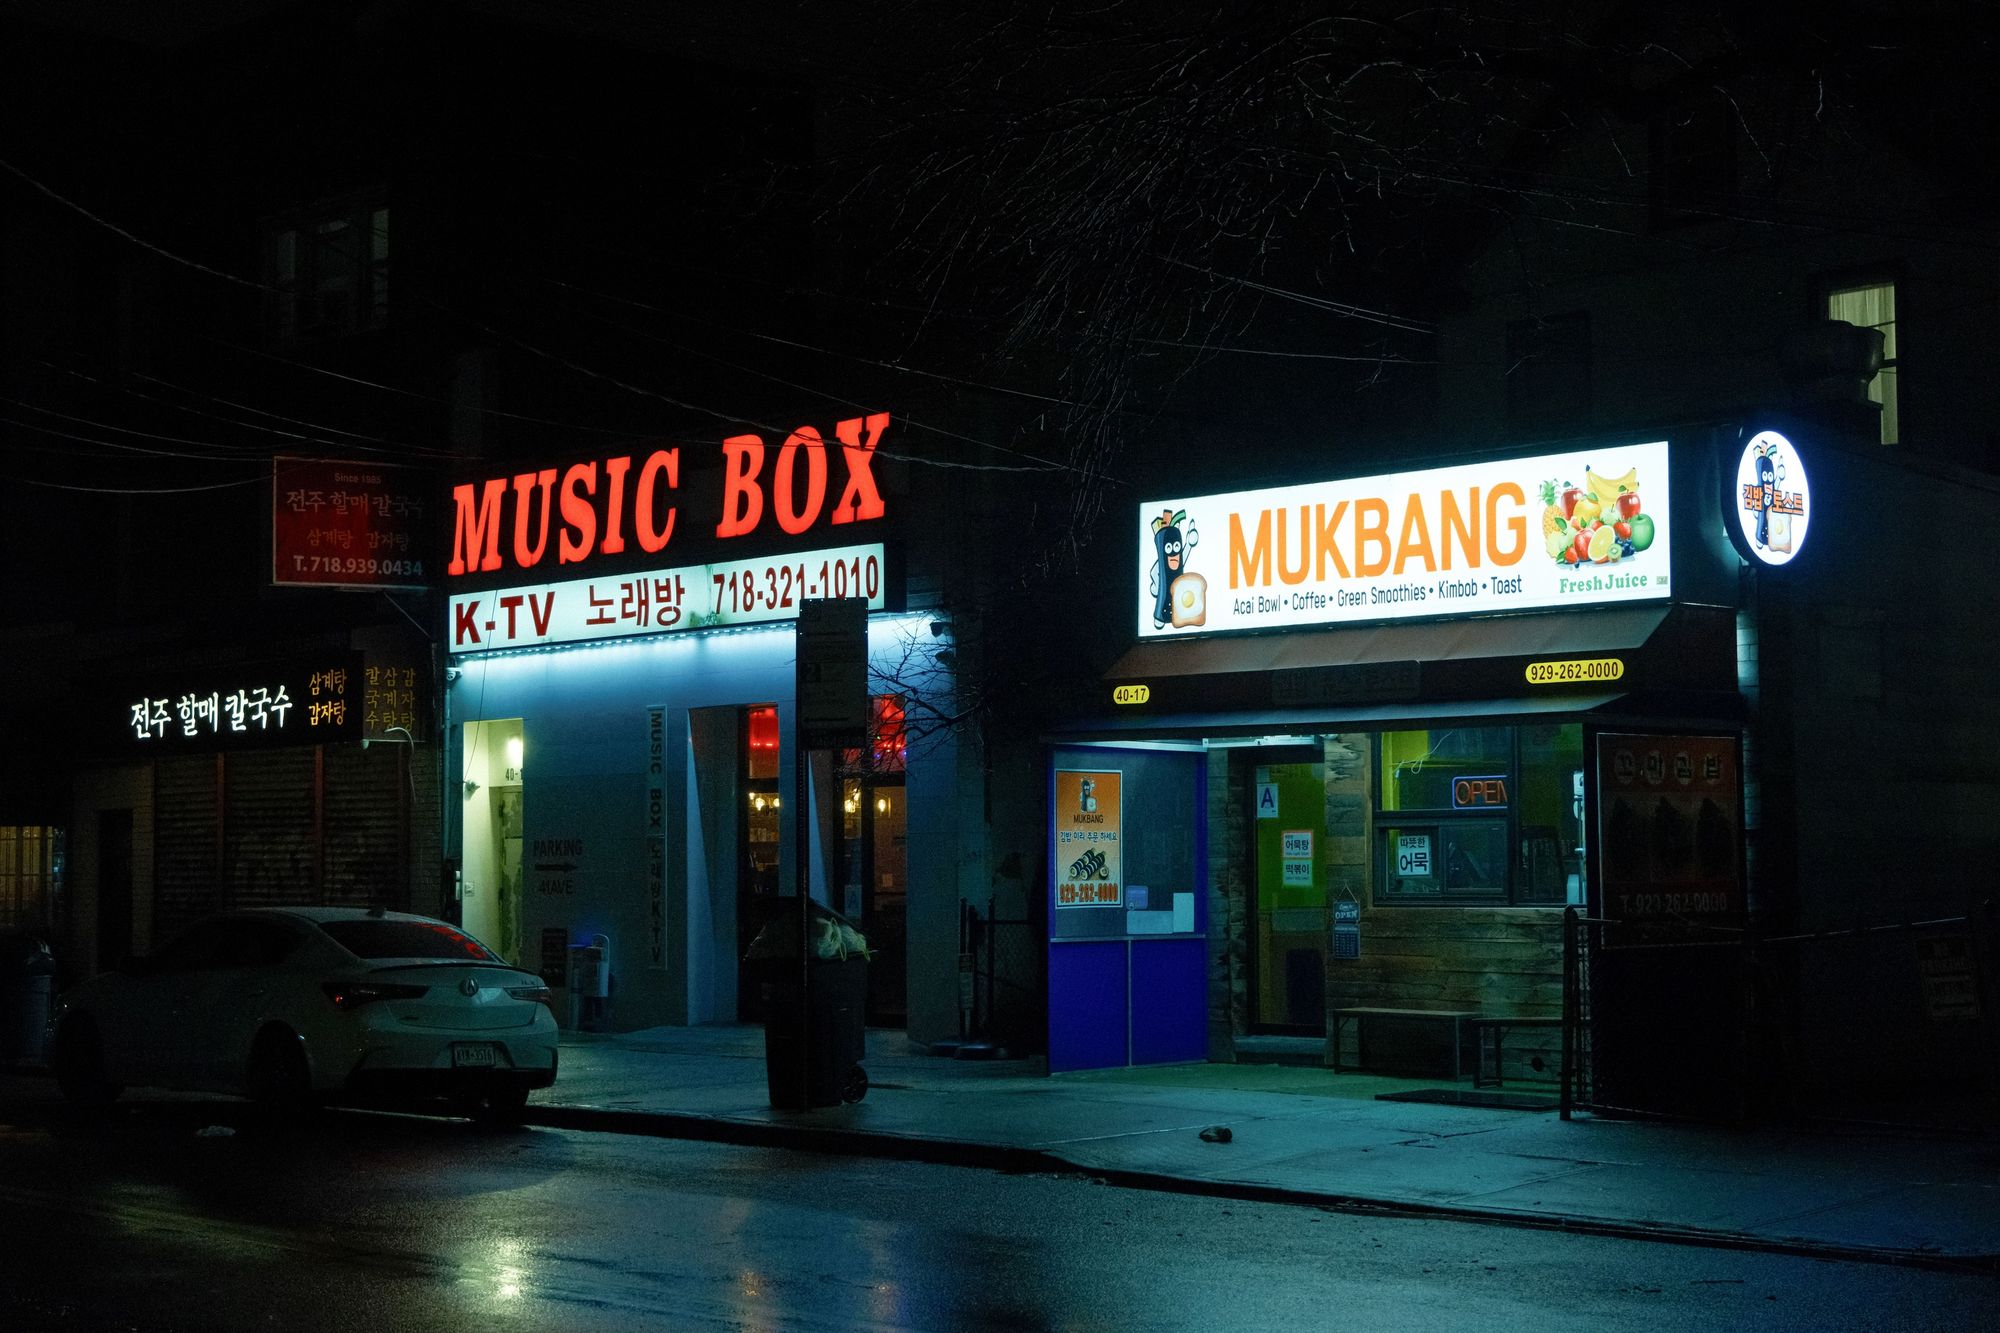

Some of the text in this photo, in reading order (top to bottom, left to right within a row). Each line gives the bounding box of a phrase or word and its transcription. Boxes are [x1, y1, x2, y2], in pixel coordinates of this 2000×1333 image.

[286, 489, 425, 520] 전주 할매 칼국수
[448, 412, 890, 576] MUSIC BOX
[1743, 484, 1804, 516] 김밥 토스트
[306, 528, 410, 551] 삼계탕 감자탕
[1229, 482, 1527, 590] MUKBANG
[293, 555, 423, 576] T.718.939.0434
[713, 555, 879, 615] 718-321-1010
[1233, 574, 1523, 615] Acai Bowl Coffee Green Smoothies Kimbob Toast
[1559, 575, 1603, 594] Fresh
[1604, 572, 1648, 590] Juice
[585, 574, 686, 627] 노래방
[455, 591, 555, 646] K-TV
[308, 668, 348, 696] 삼계탕
[1531, 661, 1619, 681] 929-262-0000
[365, 666, 381, 730] 칼국수
[382, 666, 399, 730] 삼계탕
[1117, 688, 1146, 702] 40-17
[131, 685, 293, 739] 전주 할매 칼국수
[308, 699, 347, 726] 감자탕
[650, 713, 662, 828] MUSIC BOX
[1261, 787, 1275, 808] A
[1456, 780, 1508, 805] OPEN
[1073, 815, 1104, 824] MUKBANG
[534, 839, 583, 857] PARKING
[1400, 837, 1426, 848] 따뜻한
[1400, 853, 1429, 873] 어묵
[1335, 910, 1358, 919] OPEN
